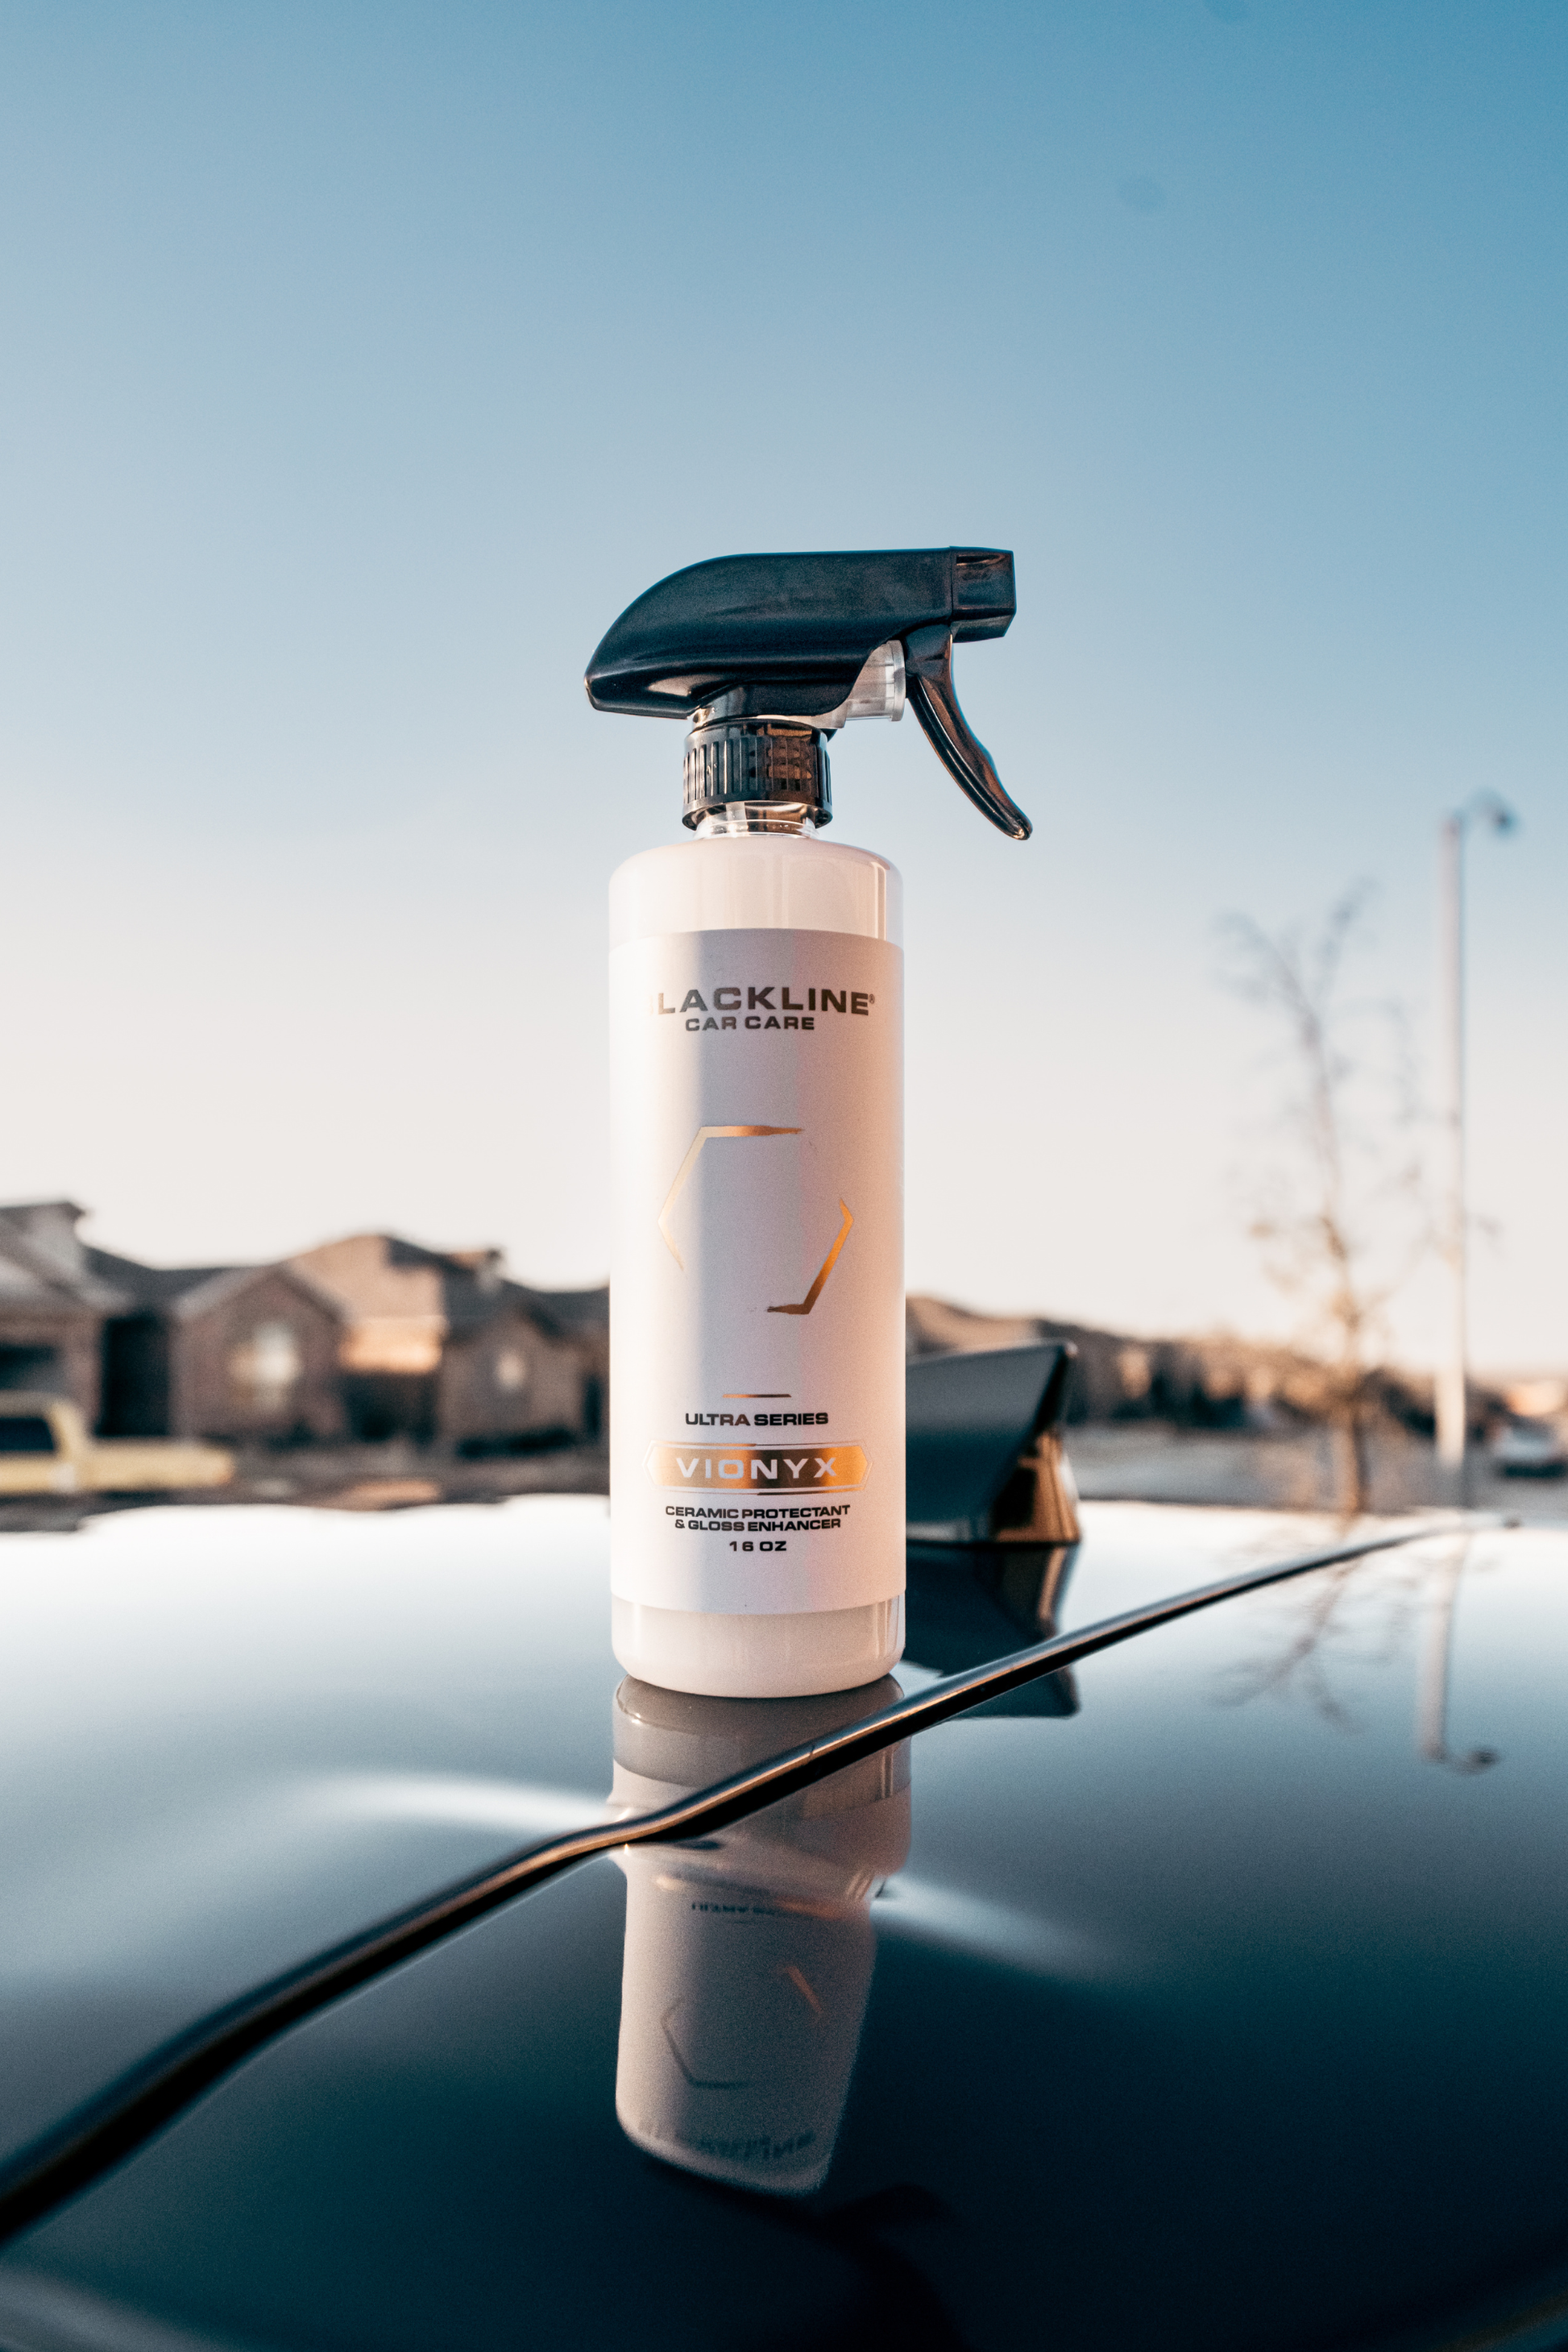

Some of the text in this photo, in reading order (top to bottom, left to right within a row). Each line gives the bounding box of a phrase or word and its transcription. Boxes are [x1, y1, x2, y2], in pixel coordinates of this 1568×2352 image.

[685, 1015, 815, 1031] CAR CARE
[685, 1412, 828, 1426] ULTRA SERIES
[676, 1457, 837, 1479] VIONYX
[666, 1504, 850, 1519] CERAMIC PROTECTANT
[674, 1518, 841, 1532] & GLOSS ENHANCER
[729, 1541, 787, 1552] 16 OZ
